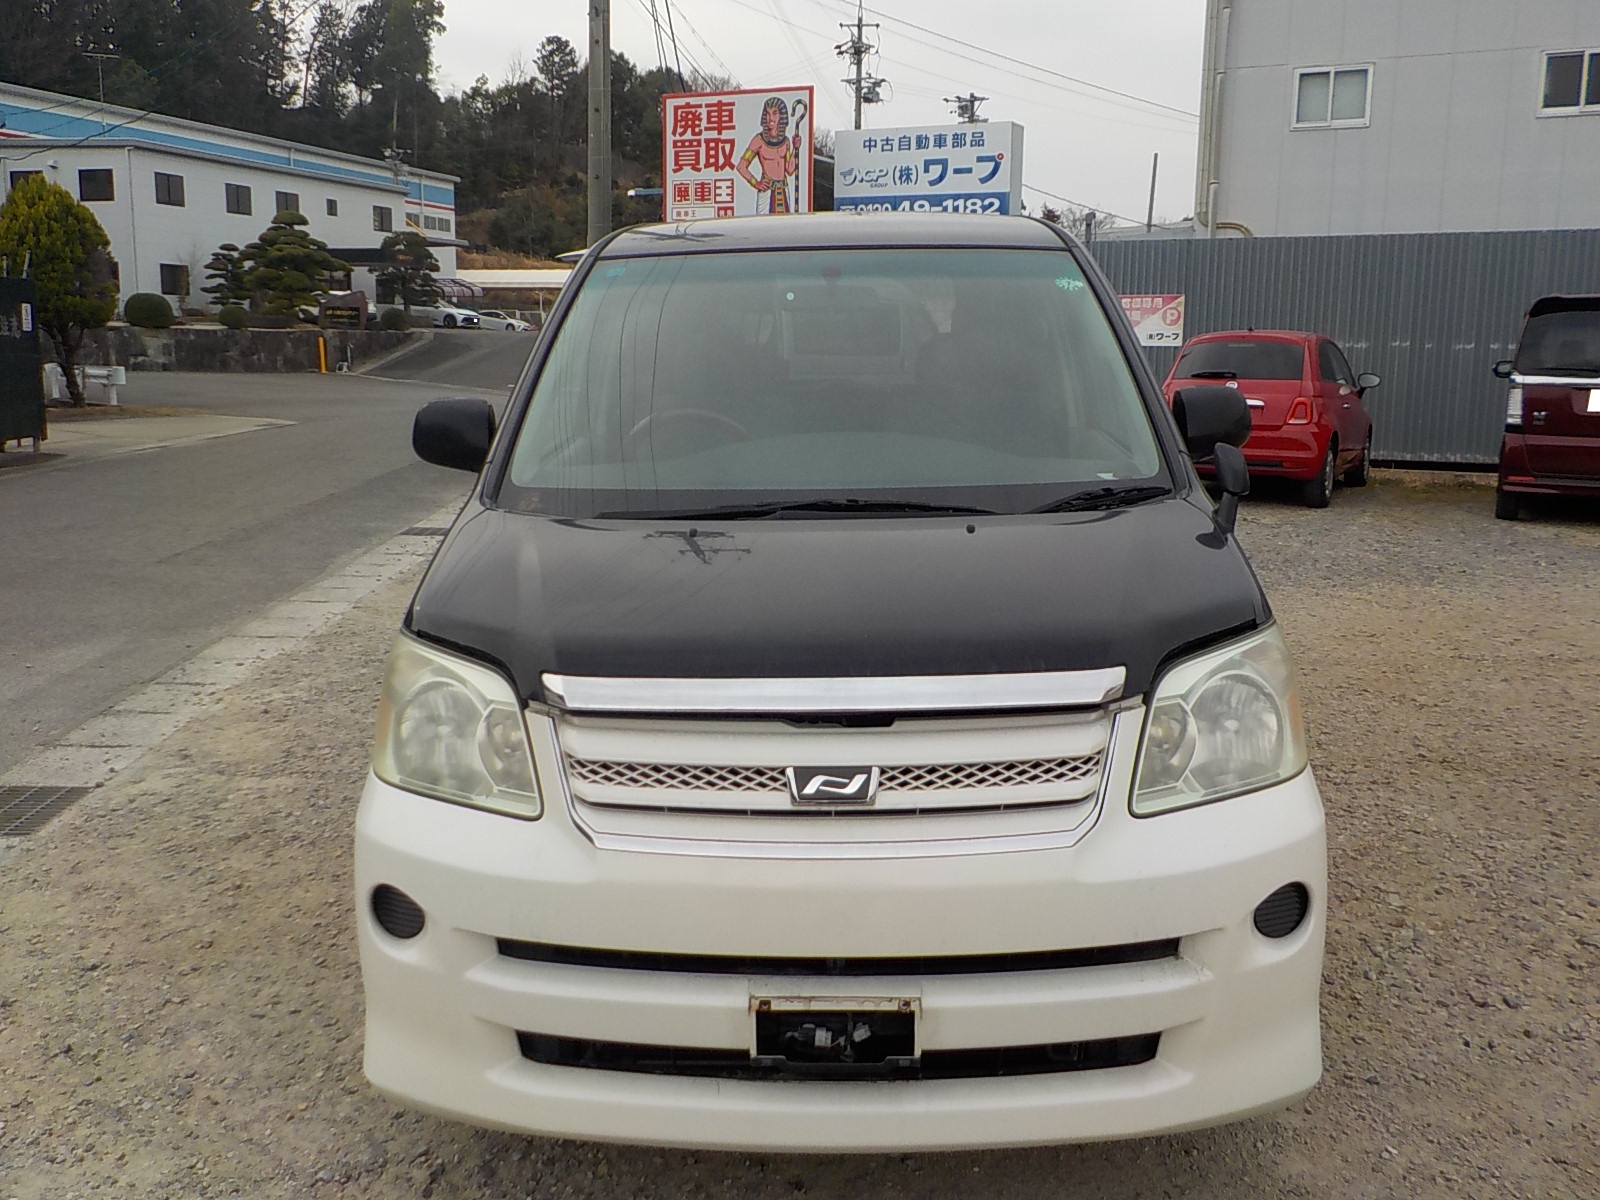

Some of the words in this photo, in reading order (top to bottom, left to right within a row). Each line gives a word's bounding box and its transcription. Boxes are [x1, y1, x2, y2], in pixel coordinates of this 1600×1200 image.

[672, 100, 736, 137] 廃車
[672, 138, 736, 173] 買取
[863, 131, 985, 153] 中古自動車部品
[897, 198, 1001, 215] 49-1182
